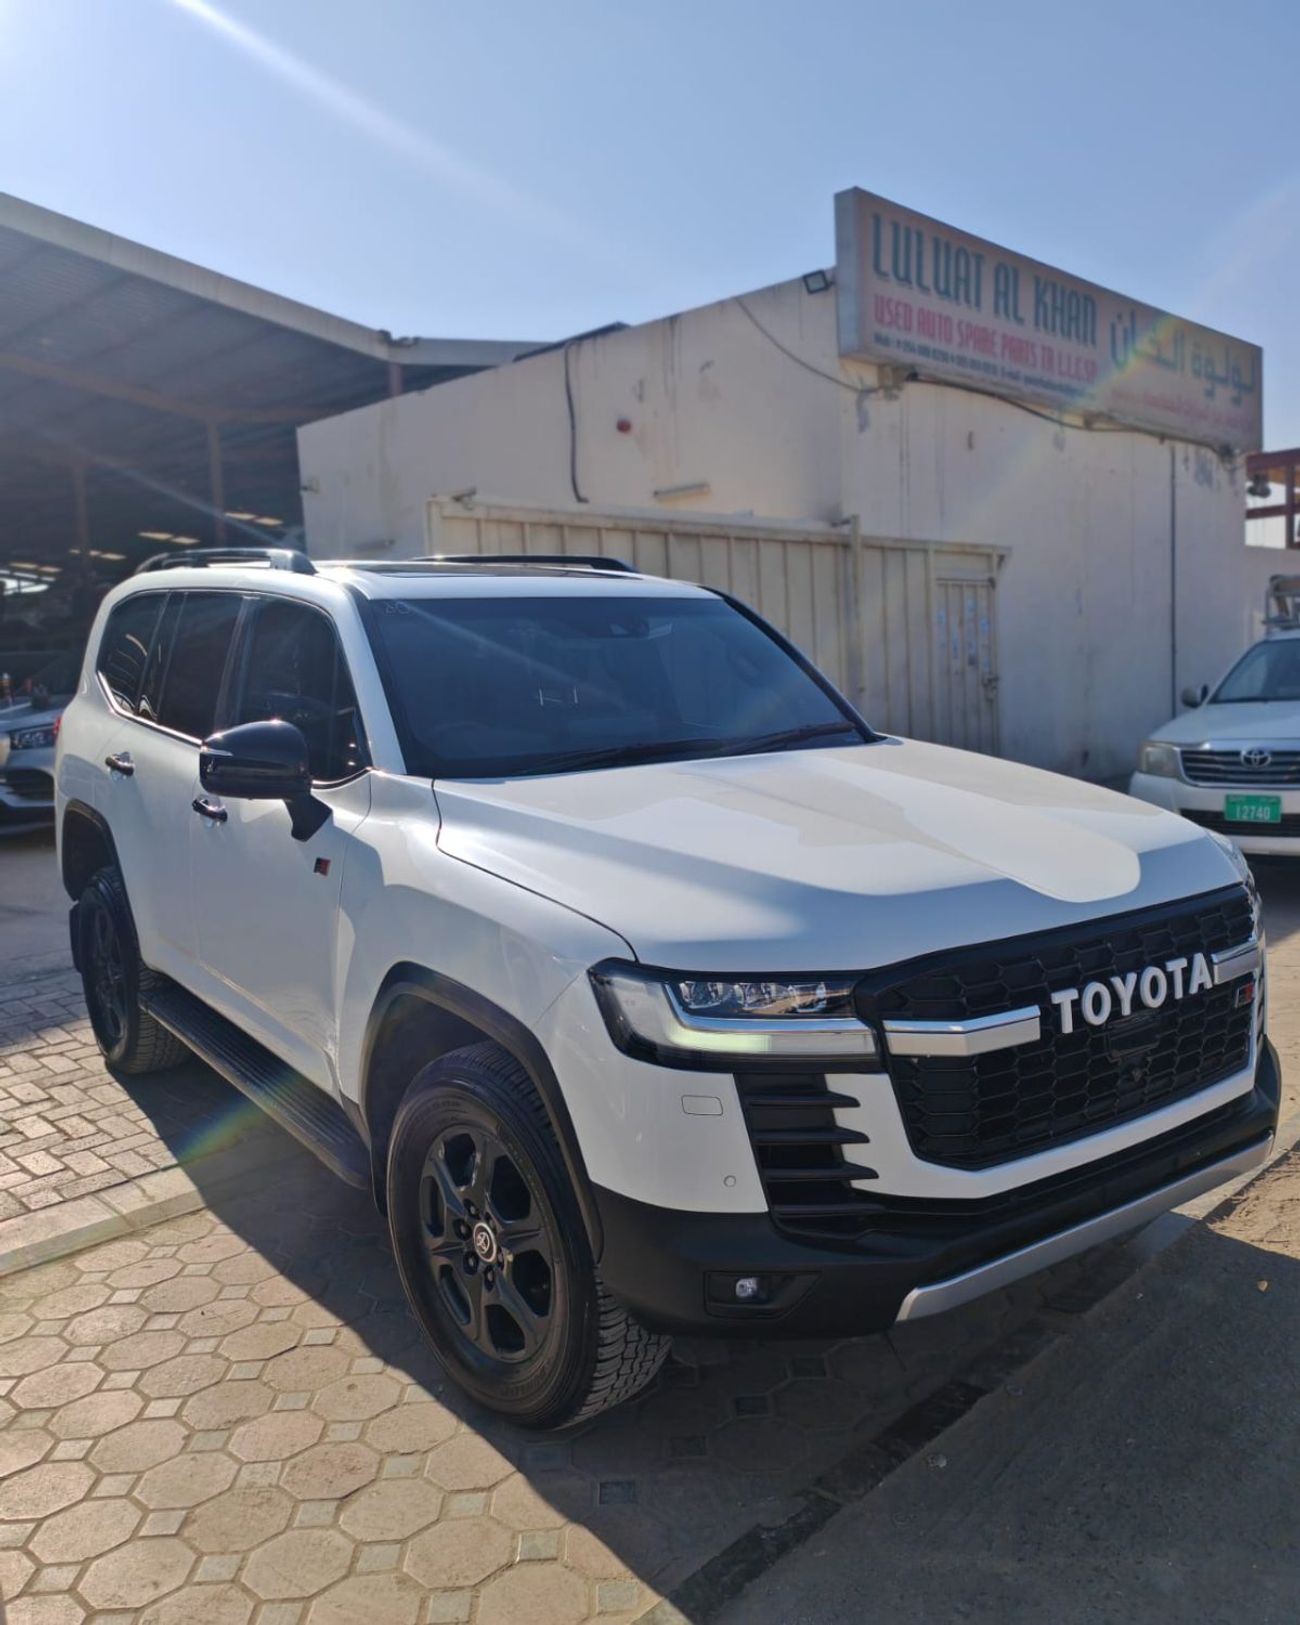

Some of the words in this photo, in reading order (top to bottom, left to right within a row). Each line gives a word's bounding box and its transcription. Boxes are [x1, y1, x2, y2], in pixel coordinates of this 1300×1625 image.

[874, 294, 913, 334] USED
[917, 307, 953, 346] AUTO
[957, 319, 997, 360] SPARE
[1001, 331, 1037, 370] PARTS
[993, 260, 1025, 325] AL
[1034, 273, 1098, 348] KHAN
[1051, 952, 1213, 1034] TOYOTA
